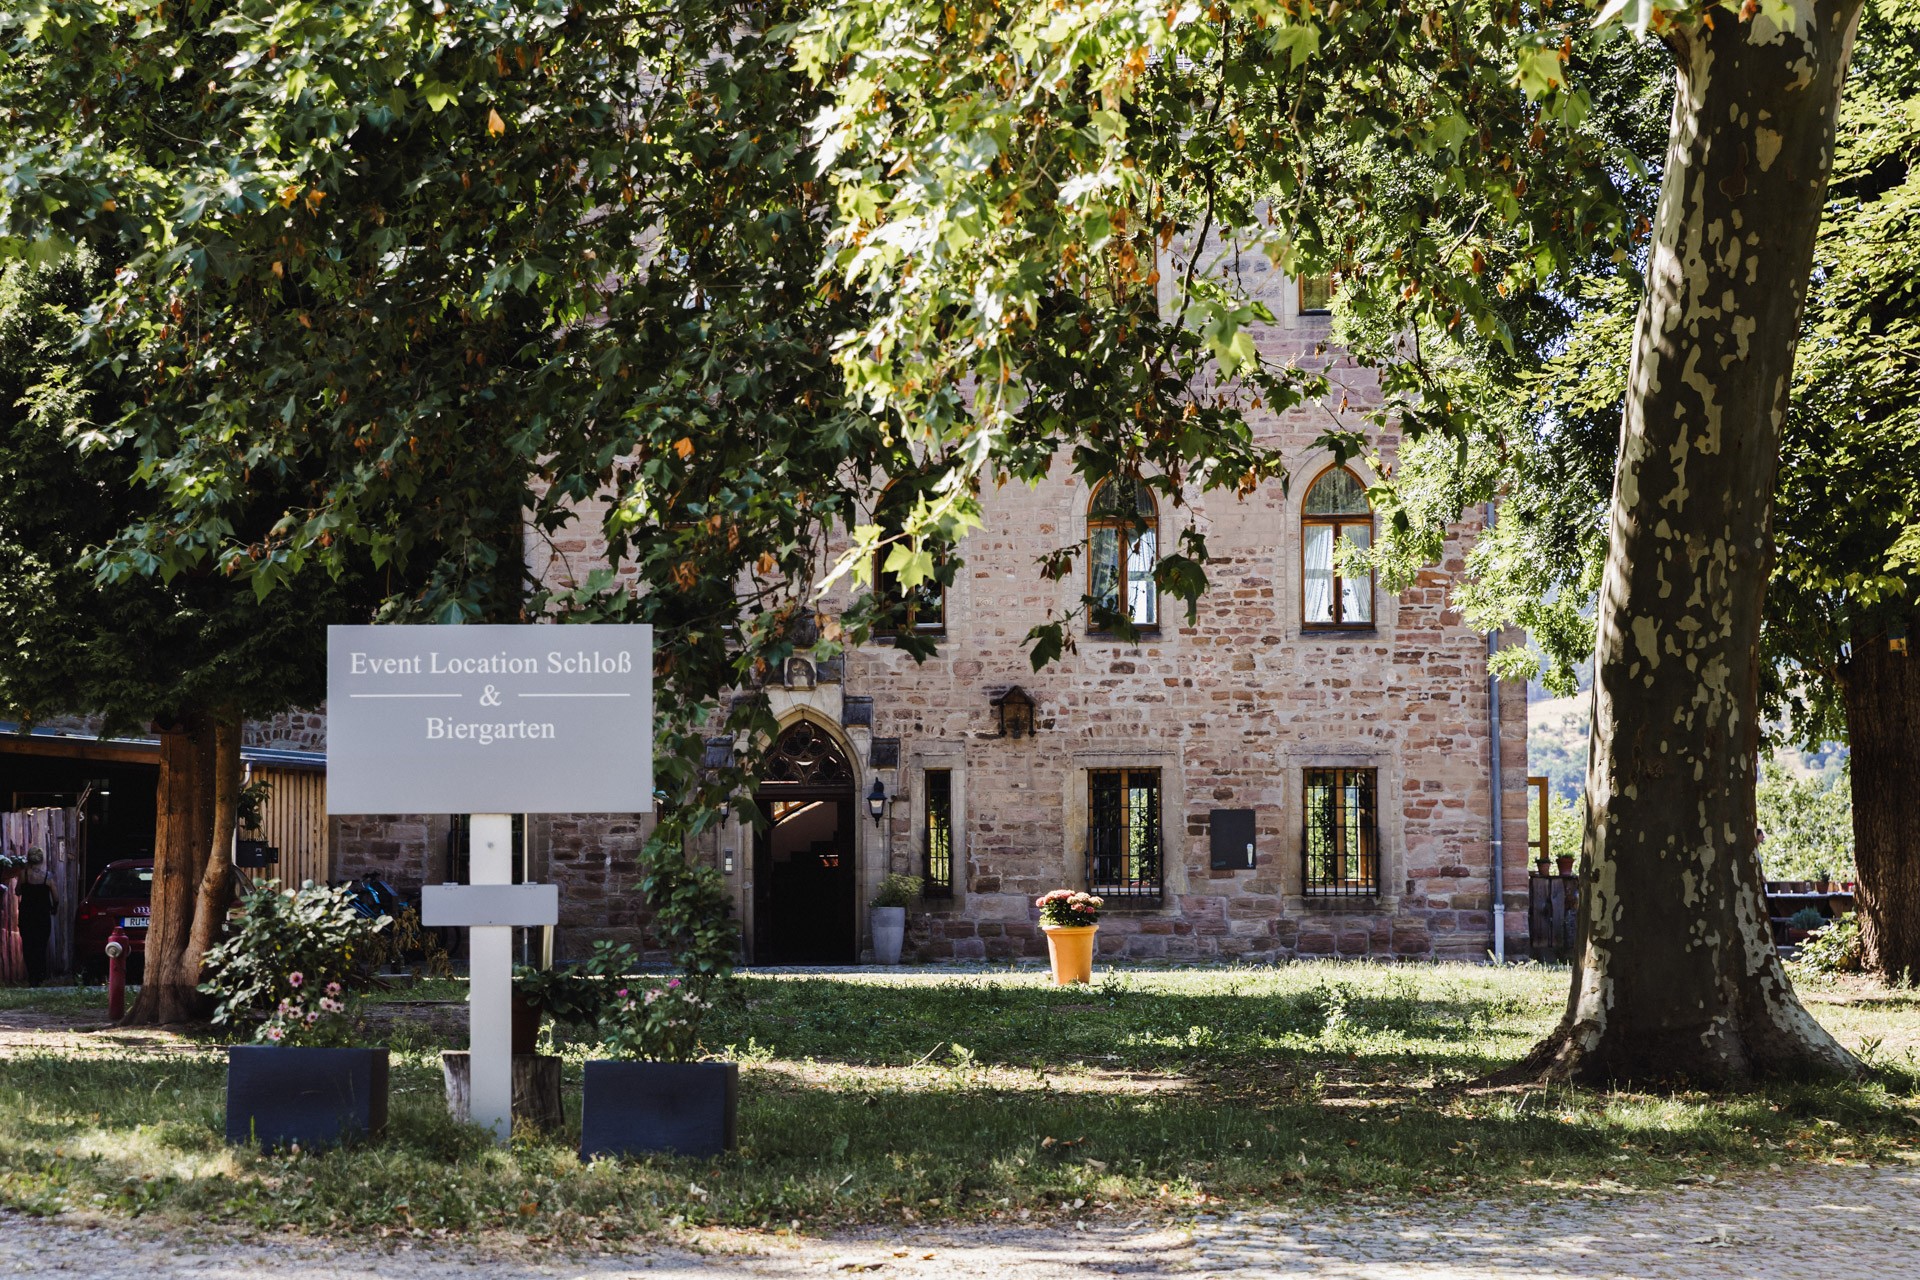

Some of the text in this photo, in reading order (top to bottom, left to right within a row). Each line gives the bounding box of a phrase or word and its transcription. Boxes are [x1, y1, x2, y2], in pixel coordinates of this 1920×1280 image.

[350, 651, 632, 674] Event Location Schloß
[478, 684, 503, 706] &
[425, 716, 556, 745] Biergarten
